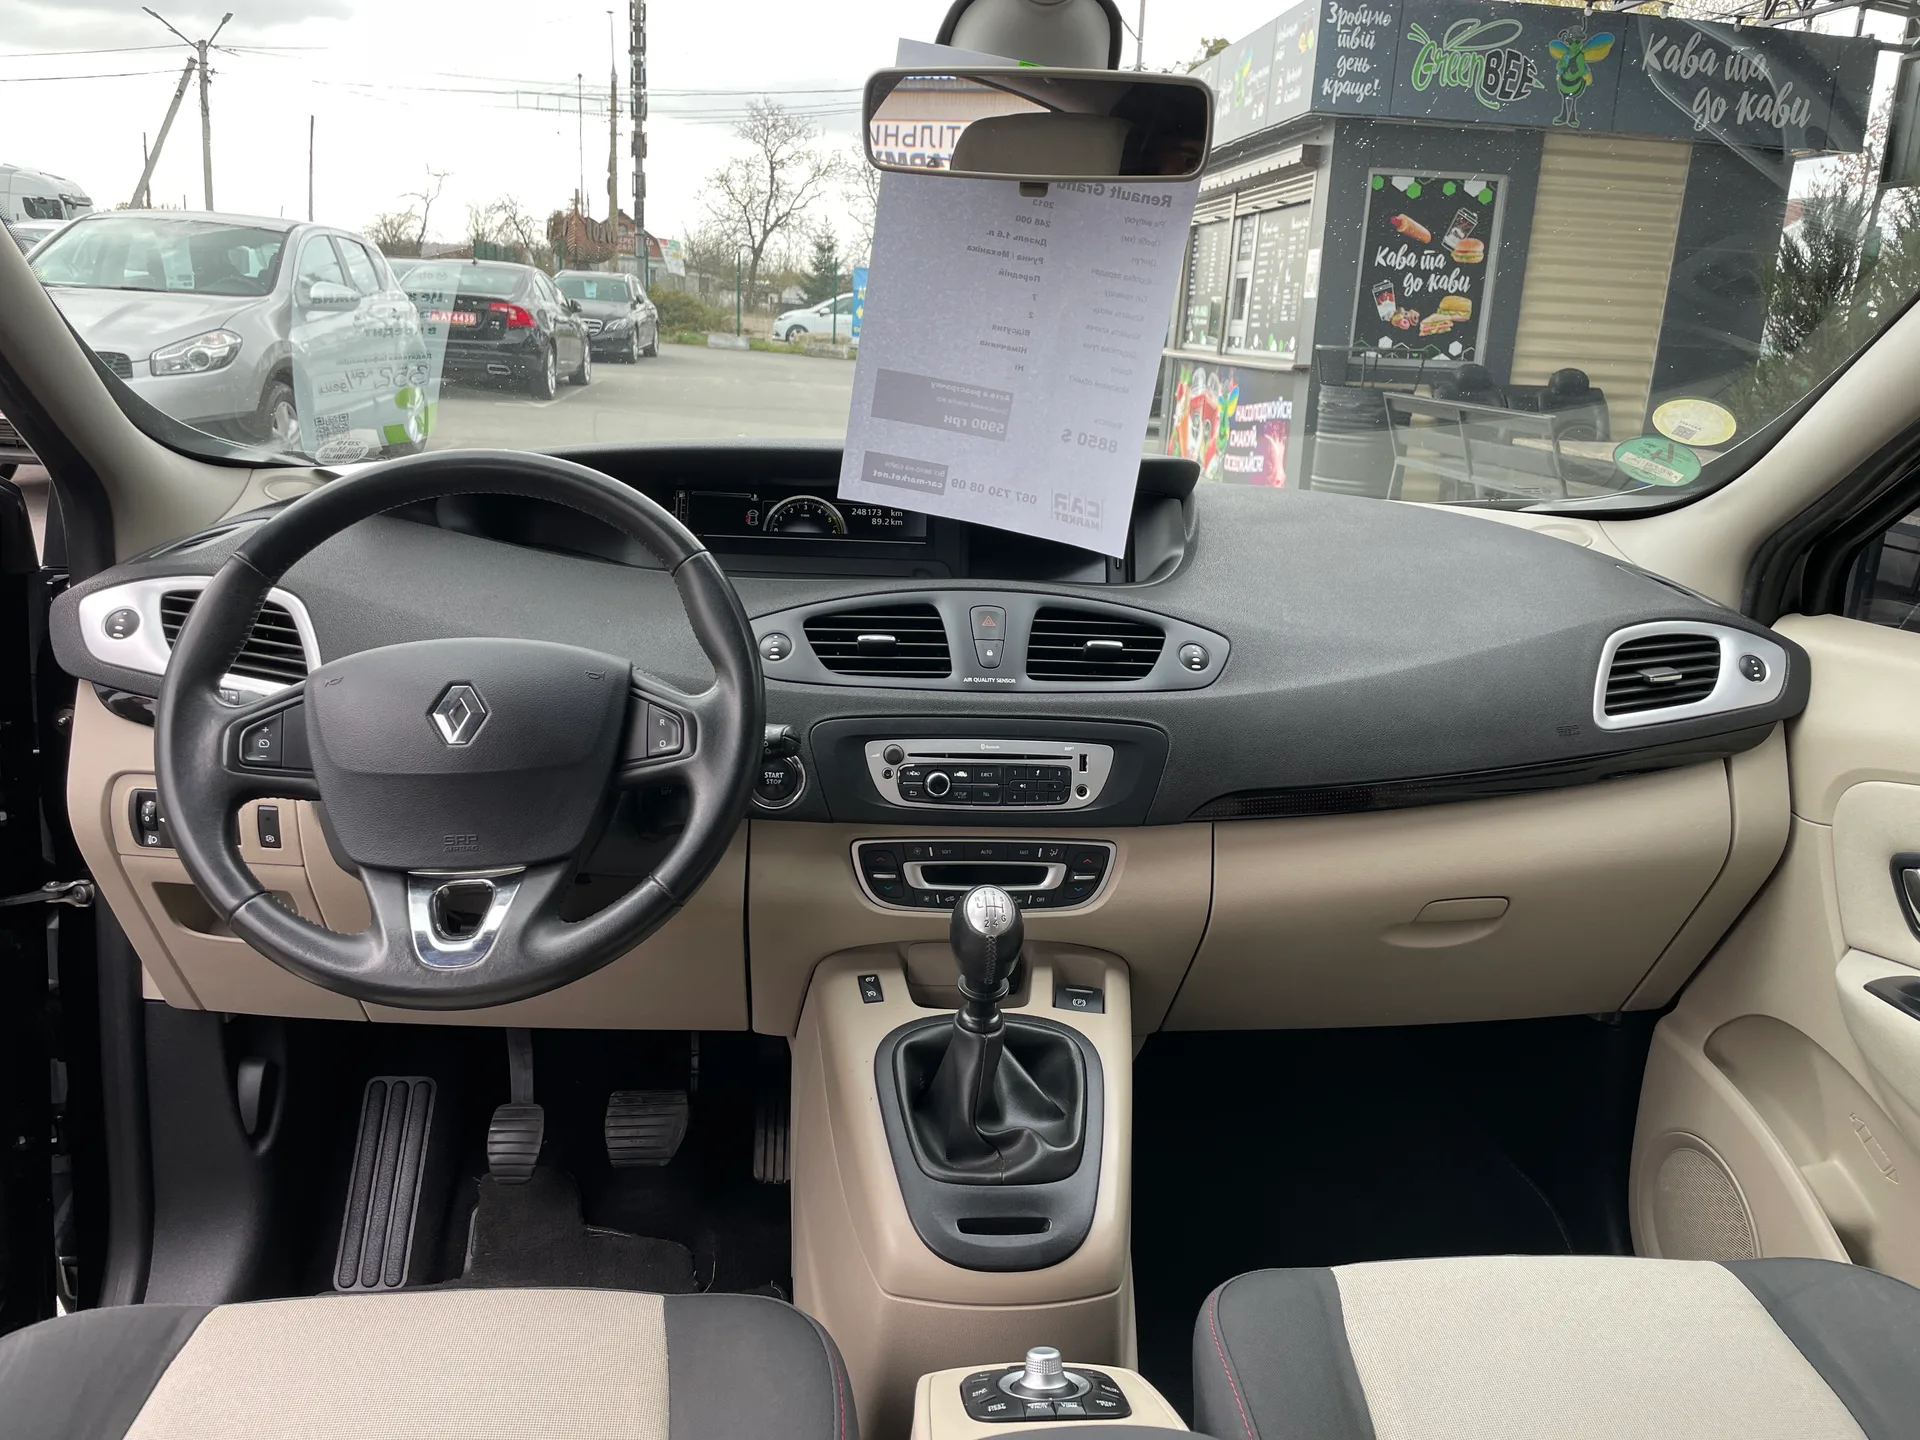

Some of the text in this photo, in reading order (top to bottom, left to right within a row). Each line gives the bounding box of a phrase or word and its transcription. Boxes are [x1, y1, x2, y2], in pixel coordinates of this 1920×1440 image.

[1326, 1, 1392, 32] Зробимо
[1337, 26, 1376, 50] твій
[1336, 55, 1371, 78] день
[1641, 31, 1770, 83] Кава та
[1321, 77, 1381, 104] краще!
[1692, 81, 1812, 132] до кави
[1374, 243, 1447, 270] Кава та
[1402, 267, 1471, 297] до кави
[851, 508, 903, 517] 248173 km
[871, 518, 903, 527] 89.2 km
[659, 718, 666, 726] R
[764, 771, 784, 779] START
[984, 919, 990, 928] 2
